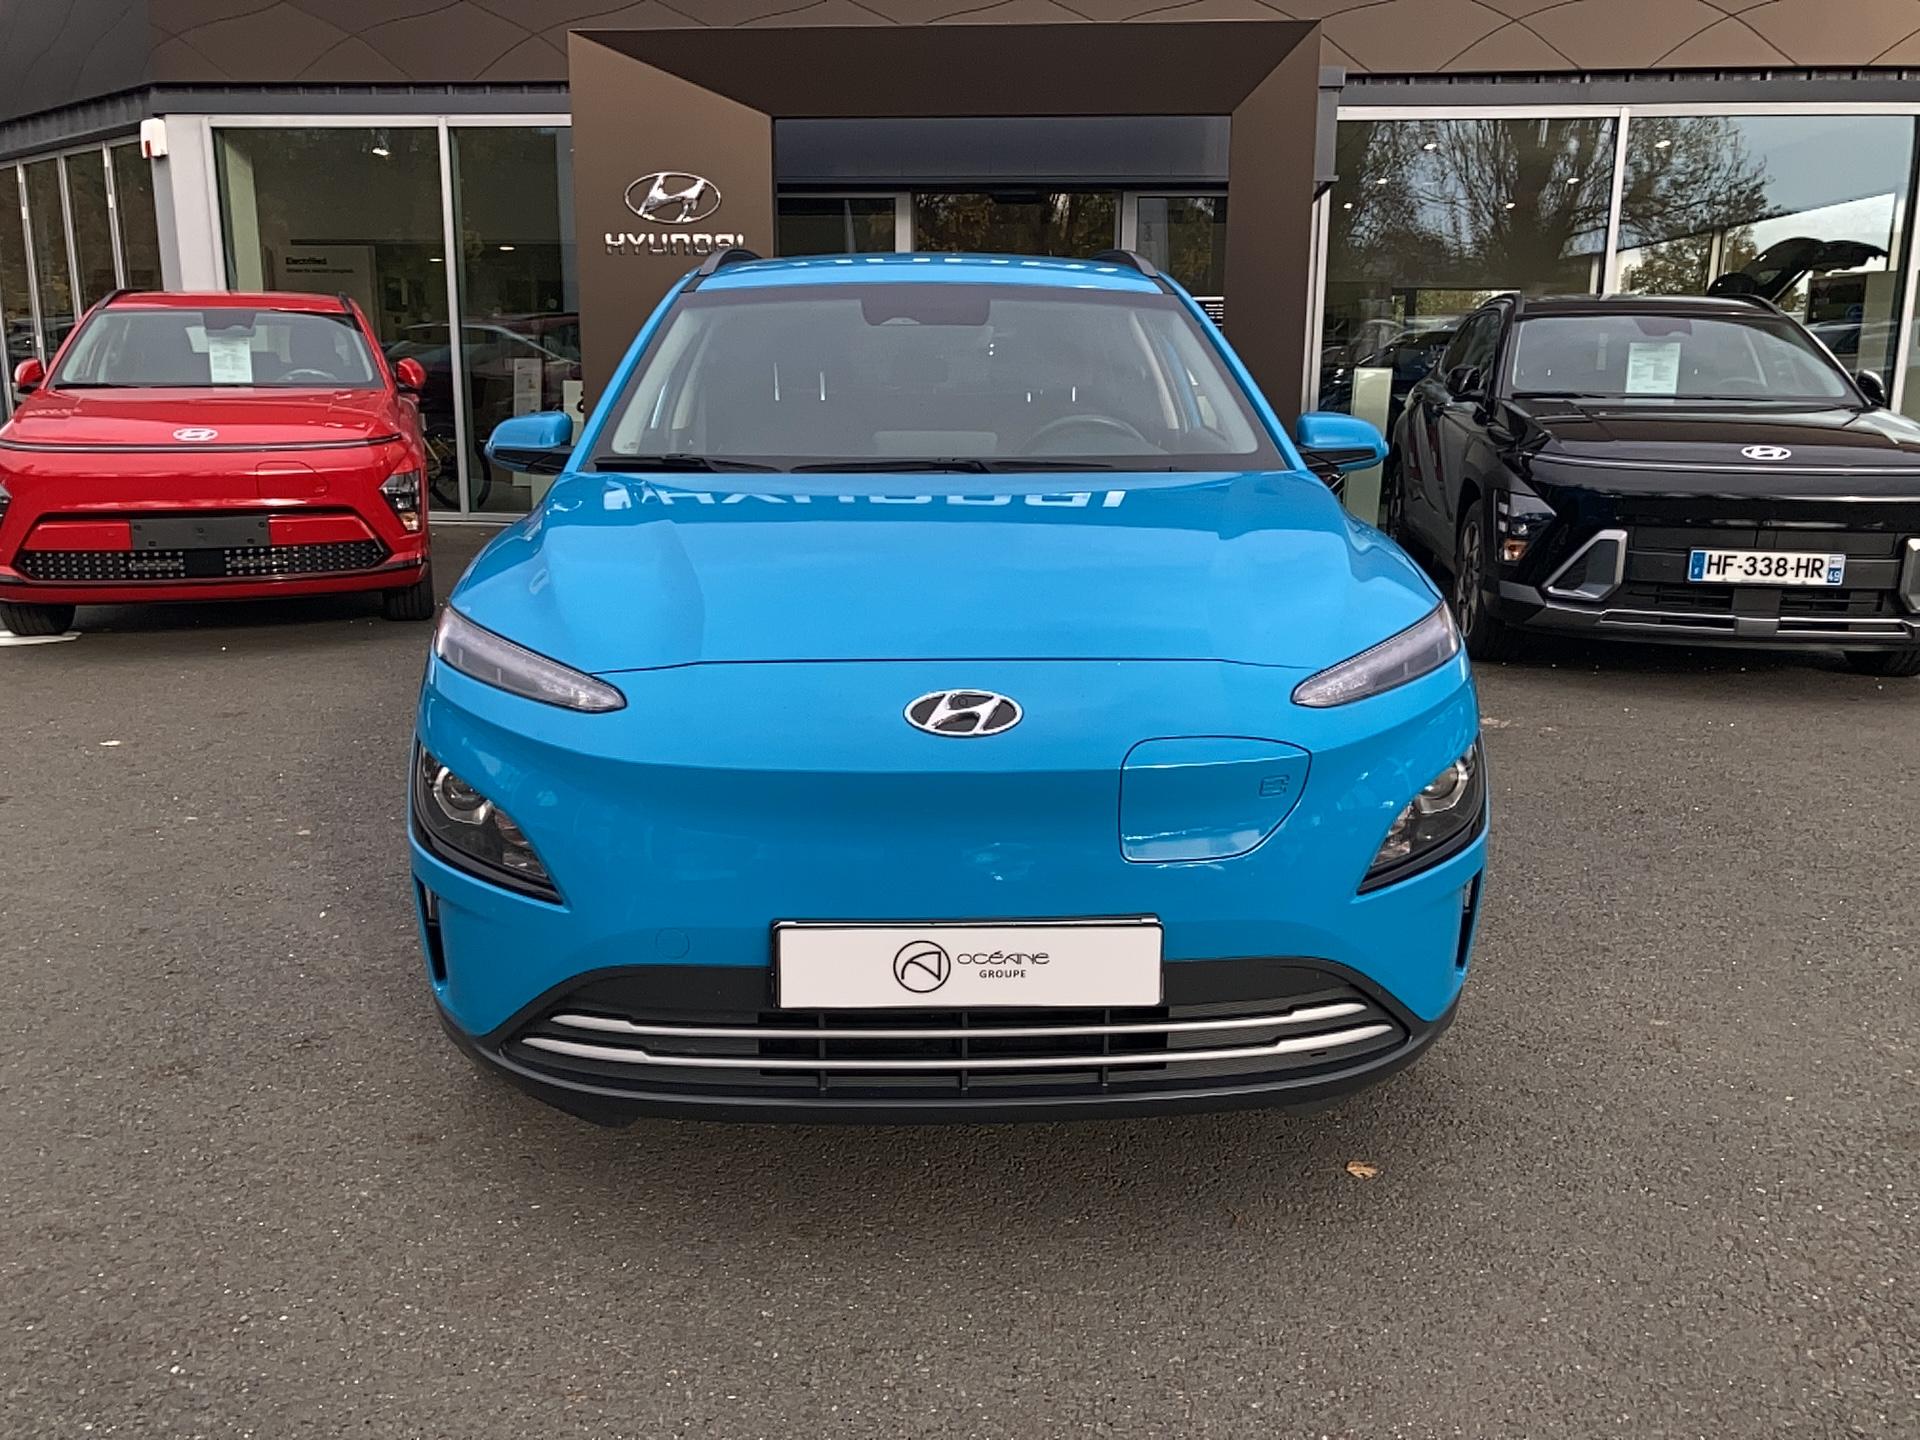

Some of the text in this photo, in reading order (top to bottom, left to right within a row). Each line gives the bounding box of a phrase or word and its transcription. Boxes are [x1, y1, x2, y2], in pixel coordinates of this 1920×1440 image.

[605, 233, 744, 255] HYUNDAI
[1706, 554, 1825, 579] HF-338-HR
[1828, 571, 1841, 582] 49
[979, 969, 1027, 979] GROUPE
